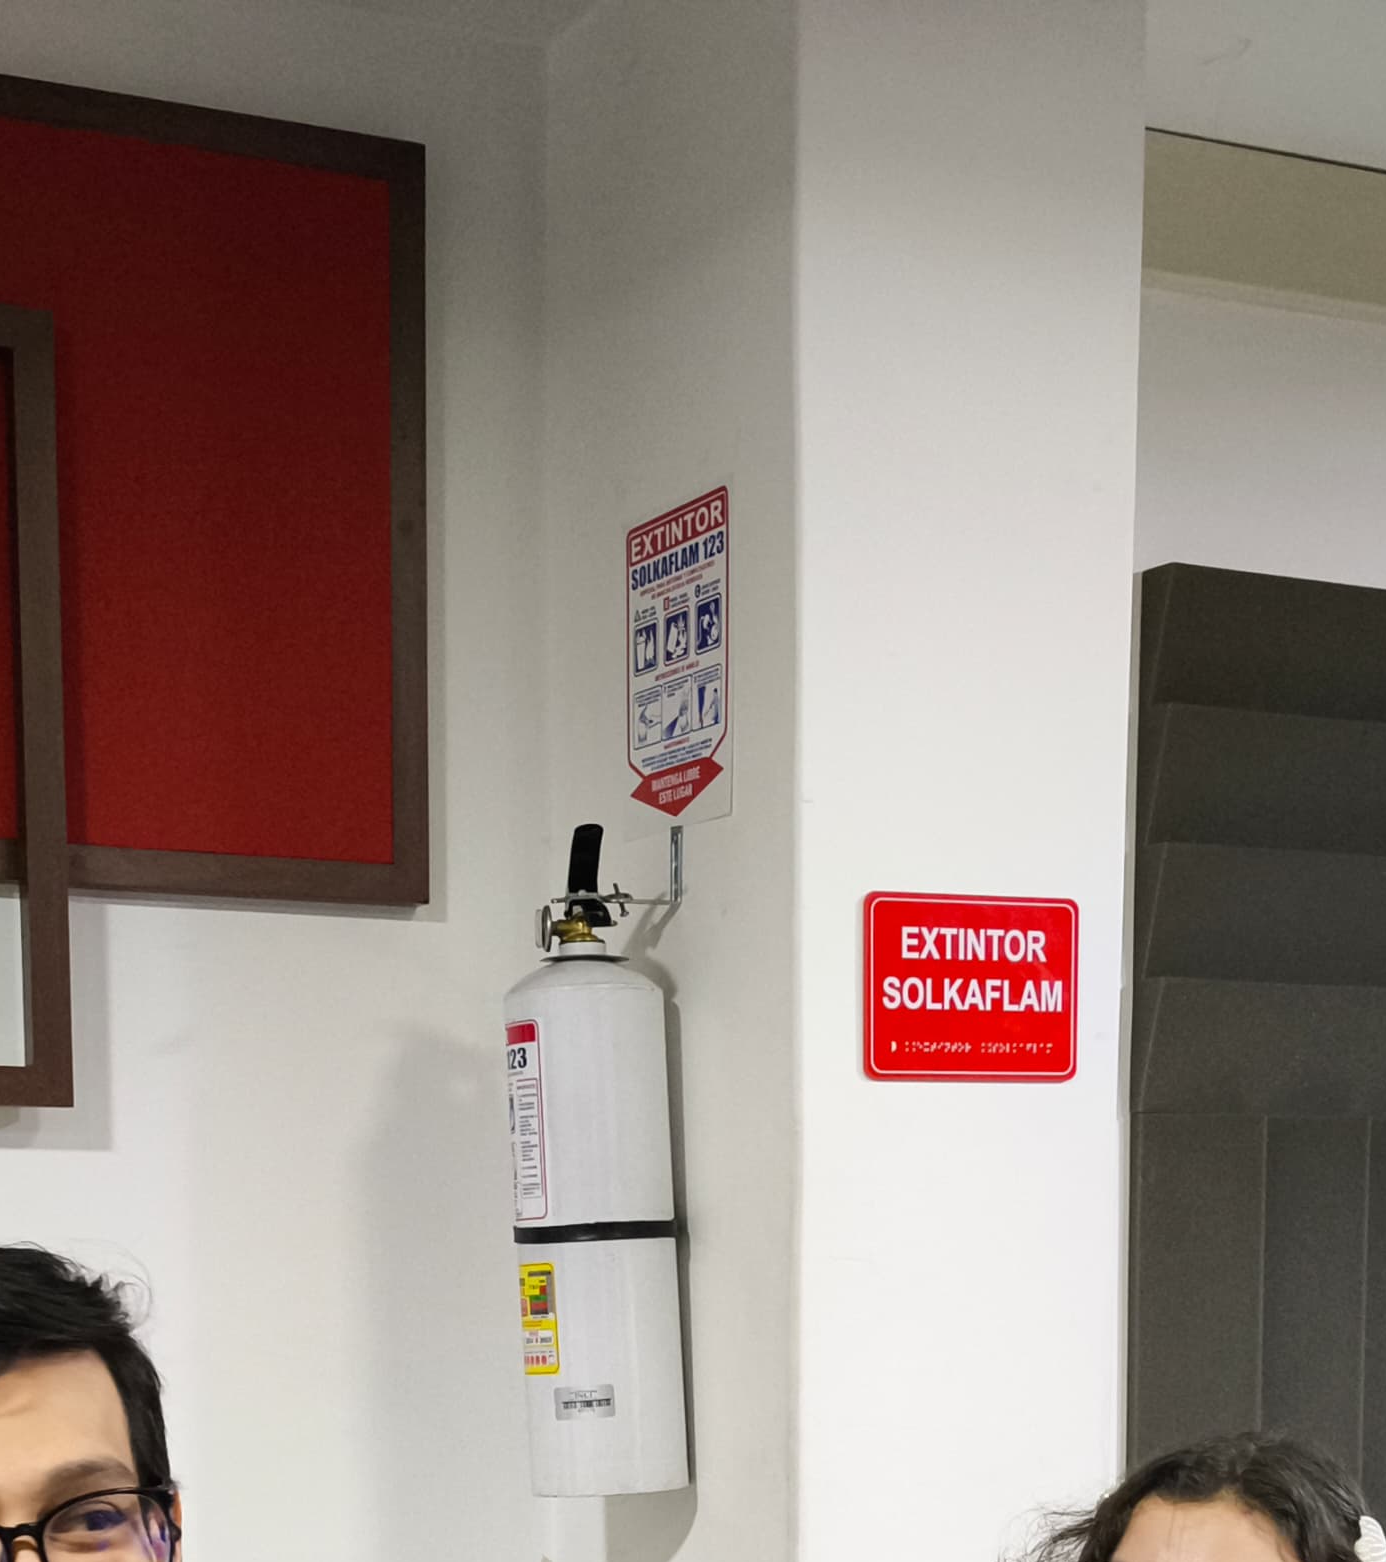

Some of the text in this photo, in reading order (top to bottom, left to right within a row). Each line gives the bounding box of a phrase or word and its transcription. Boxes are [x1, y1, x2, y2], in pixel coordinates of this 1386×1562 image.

[631, 499, 723, 563] EXTINTOR
[631, 541, 699, 591] SOLKAFLAM
[702, 530, 724, 560] 123
[900, 925, 1047, 963] EXTINTOR
[882, 976, 1063, 1013] SOLKAFLAM
